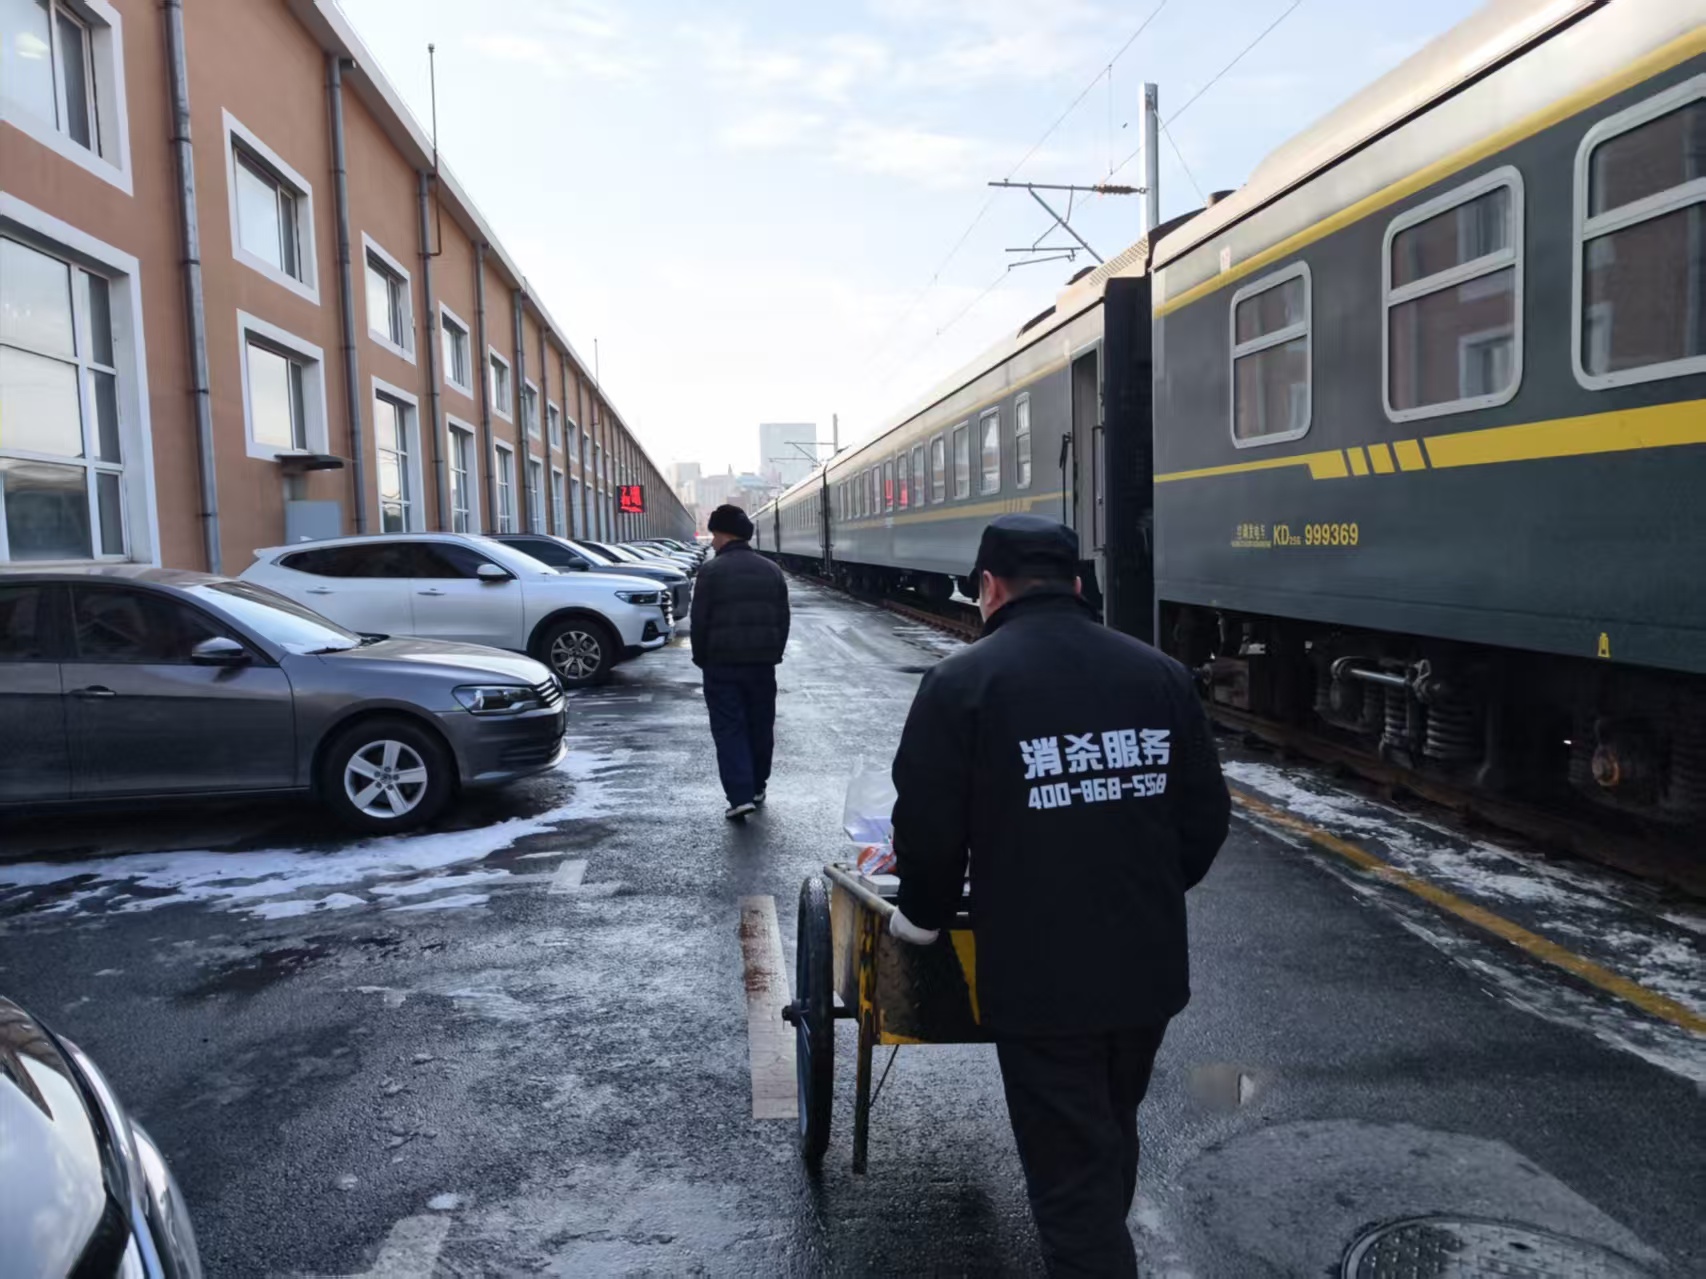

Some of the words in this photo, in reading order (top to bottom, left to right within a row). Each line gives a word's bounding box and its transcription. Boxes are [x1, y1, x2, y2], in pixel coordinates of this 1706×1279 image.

[1304, 523, 1359, 546] 999369
[1019, 728, 1171, 780] 消杀服务
